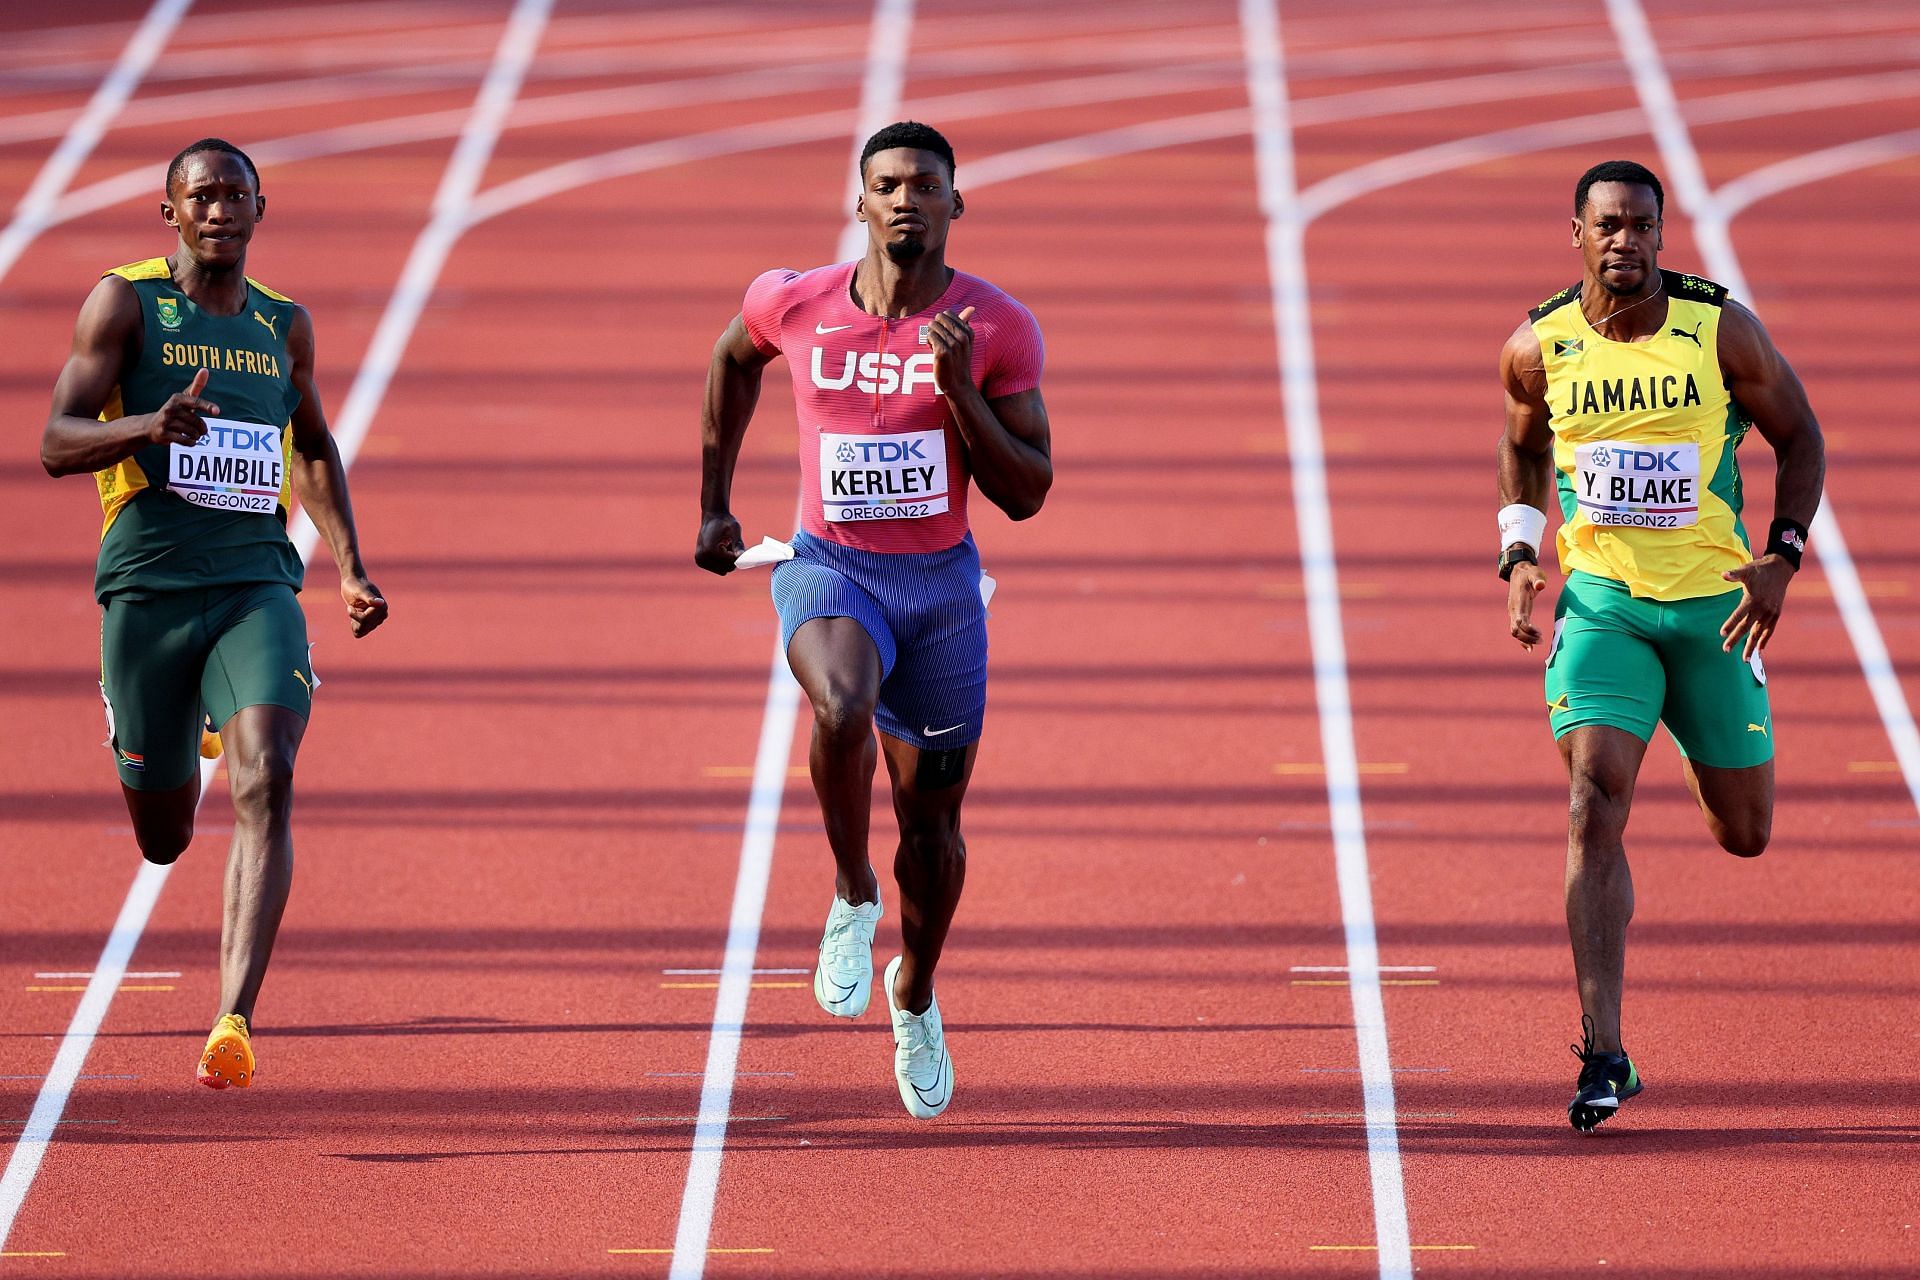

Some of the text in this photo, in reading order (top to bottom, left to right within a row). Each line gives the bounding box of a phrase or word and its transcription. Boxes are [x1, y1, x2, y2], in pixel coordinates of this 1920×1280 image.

[163, 342, 280, 378] SOUTH AFRICA
[811, 346, 945, 395] USA
[1566, 373, 1701, 416] JAMAICA
[210, 426, 275, 453] TDK
[855, 438, 927, 463] TDK
[179, 453, 281, 488] DAMBILE
[1611, 447, 1681, 472] TDK
[831, 465, 936, 496] KERLEY
[1583, 471, 1692, 504] Y. BLAKE
[186, 491, 271, 511] OREGON22
[841, 504, 930, 520] OREGON22
[1591, 511, 1677, 528] OREGON22
